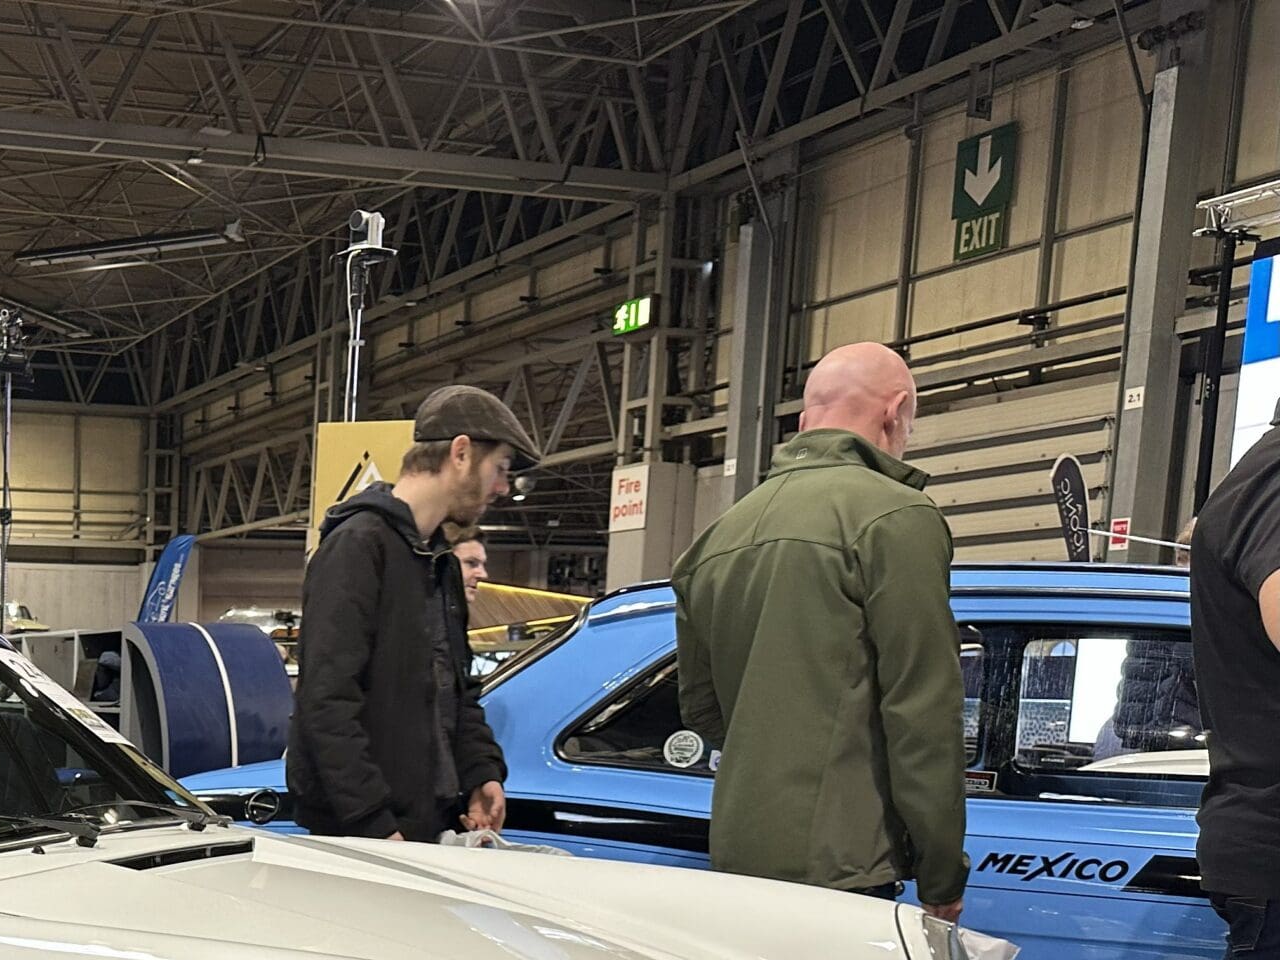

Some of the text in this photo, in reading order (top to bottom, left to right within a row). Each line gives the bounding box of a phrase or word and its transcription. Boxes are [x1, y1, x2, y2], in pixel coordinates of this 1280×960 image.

[959, 212, 1000, 254] EXIT
[1127, 393, 1141, 403] 2.1
[618, 478, 641, 495] Fire
[613, 500, 643, 522] point
[976, 852, 1129, 882] MEXICO
